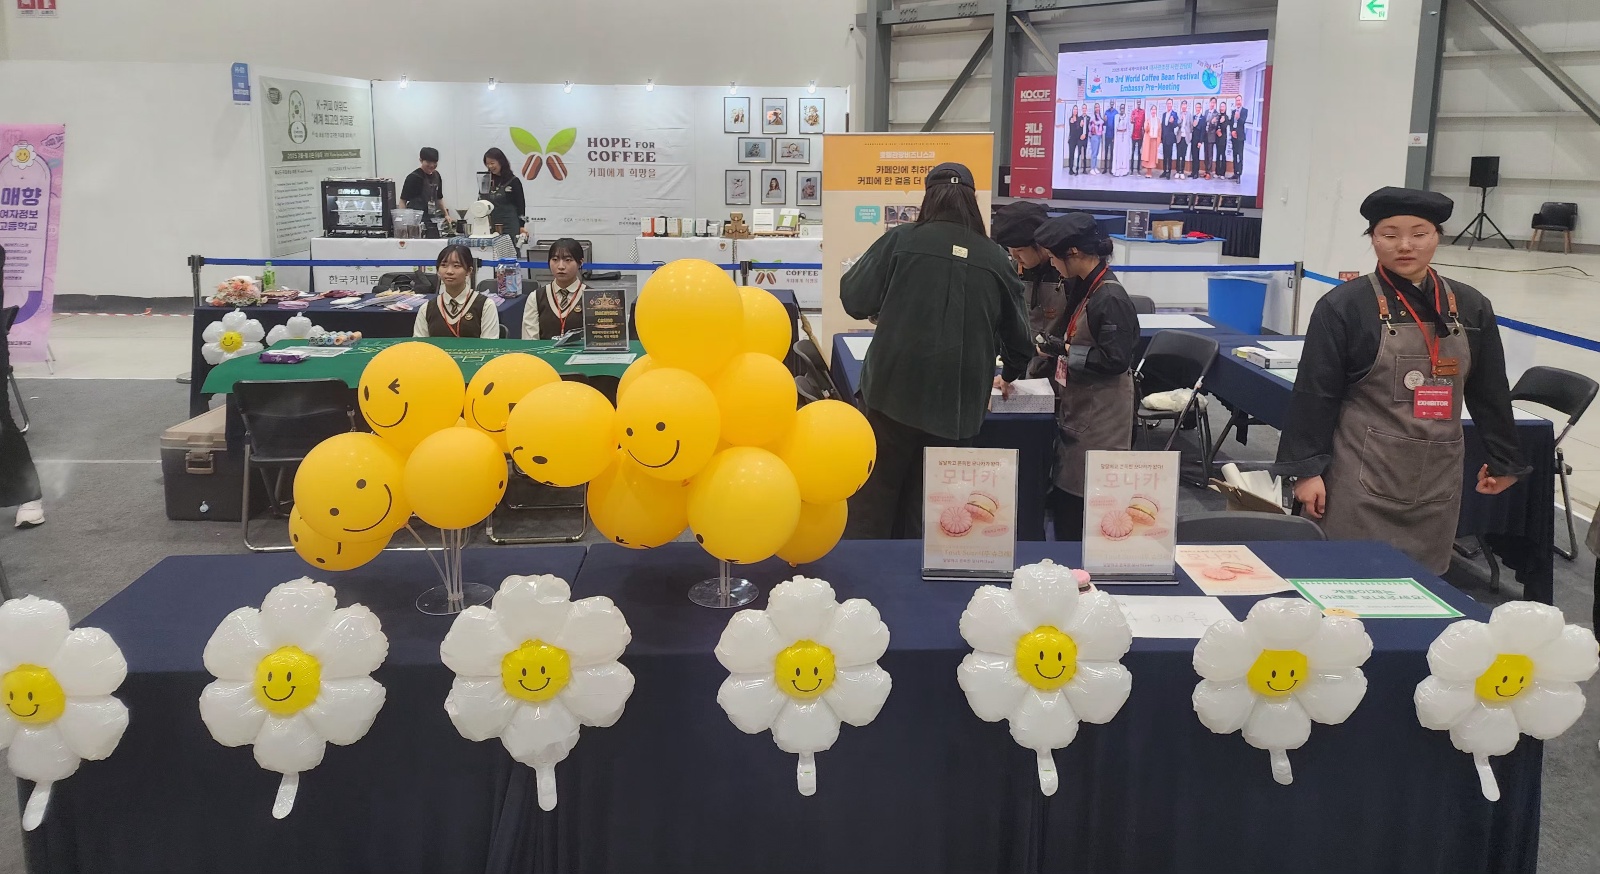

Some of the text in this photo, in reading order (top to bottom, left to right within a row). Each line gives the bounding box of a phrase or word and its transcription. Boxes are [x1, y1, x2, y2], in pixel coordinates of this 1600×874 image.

[1125, 74, 1140, 82] World
[1142, 74, 1160, 82] Coffee
[1176, 72, 1199, 80] Festival
[1120, 82, 1180, 92] Embassy Pre-Meeting
[316, 100, 348, 112] K-커피 어워드
[324, 114, 339, 126] 최고의
[1025, 123, 1042, 133] 케냐
[587, 138, 631, 148] HOPE
[1025, 135, 1041, 145] 커피
[587, 151, 656, 162] COFFEE
[1020, 148, 1045, 158] 어워드
[588, 167, 656, 178] 커피에게 희망을
[876, 165, 908, 174] 카페인에
[858, 177, 921, 186] 커피에 한 걸음 더
[1, 187, 42, 206] 매향
[0, 210, 38, 219] 여자정보
[0, 222, 37, 231] 고등학교
[942, 469, 998, 488] 모나카
[1104, 472, 1160, 490] 모나카
